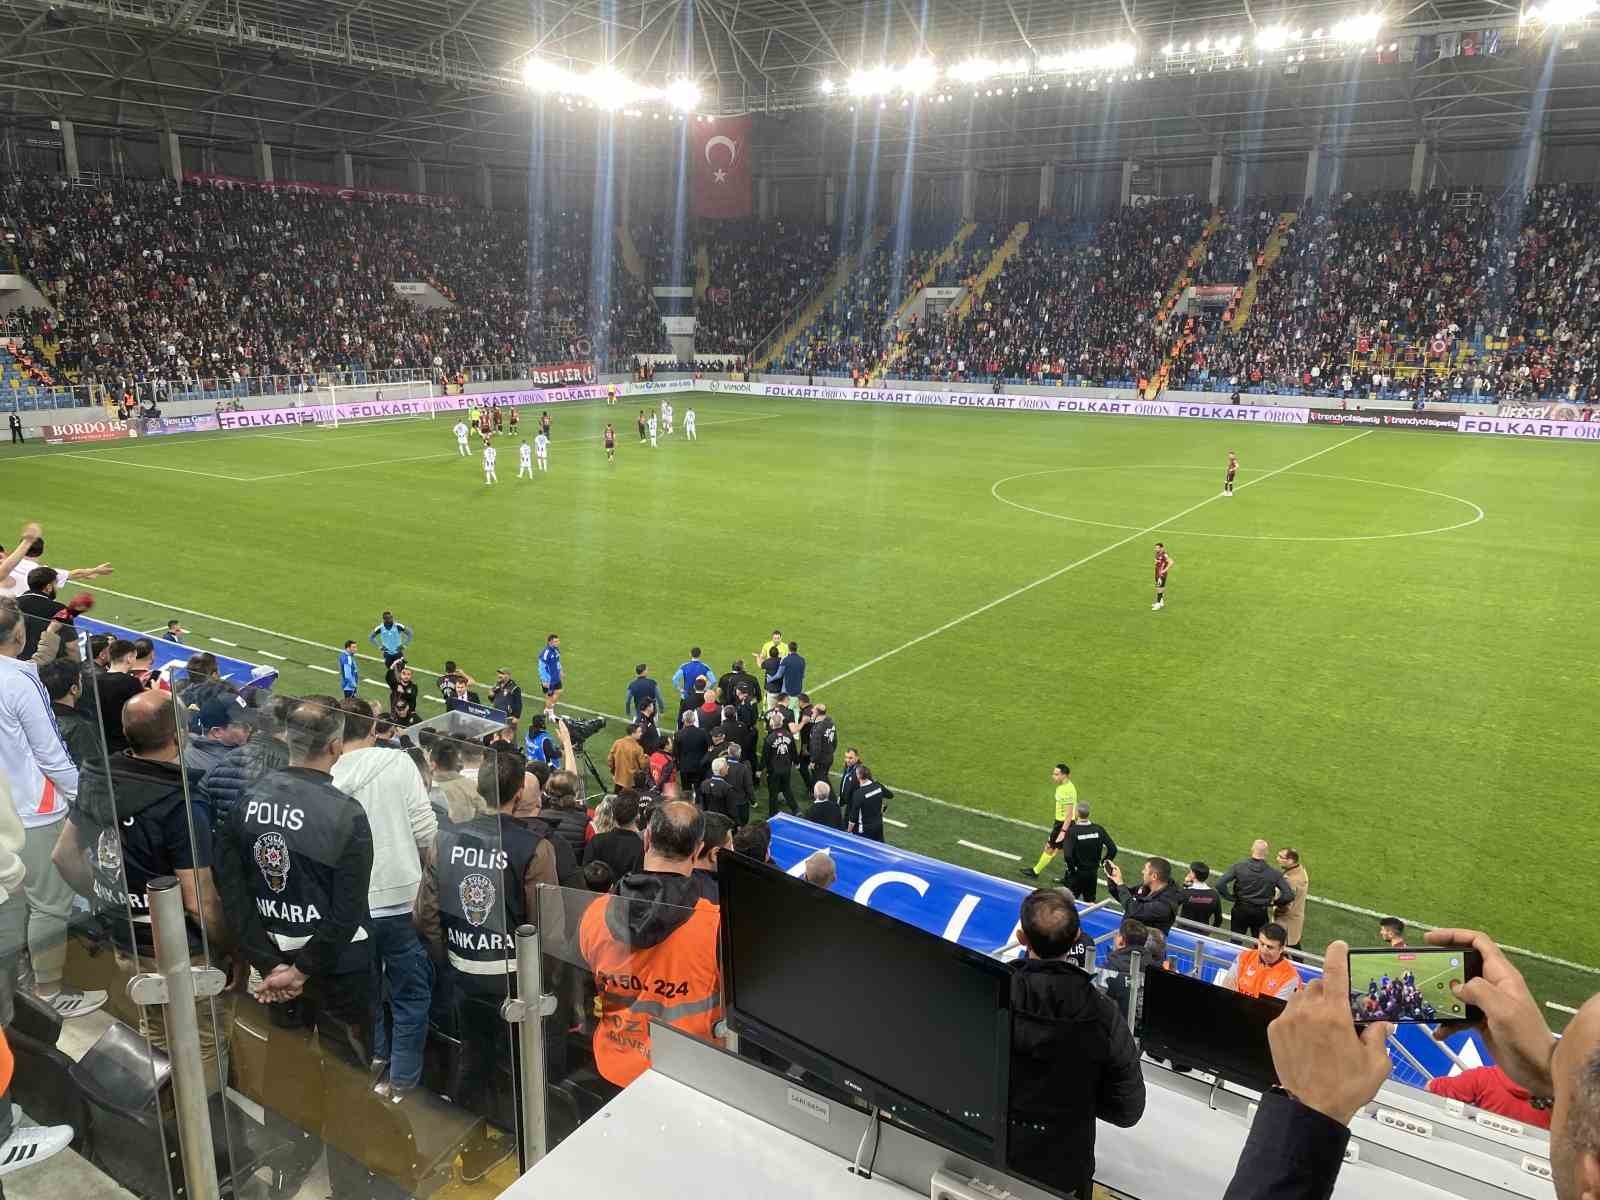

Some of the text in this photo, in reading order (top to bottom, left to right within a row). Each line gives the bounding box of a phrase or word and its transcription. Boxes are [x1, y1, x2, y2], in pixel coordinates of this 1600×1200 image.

[352, 402, 419, 417] FOLKART
[548, 390, 597, 402] FOLKART
[765, 386, 818, 397] FOLKART
[853, 391, 912, 402] FOLKART
[950, 395, 1016, 407] FOLKART
[1057, 401, 1131, 413] FOLKART
[1178, 406, 1261, 420] FOLKART
[53, 420, 128, 436] BORDO 145
[1464, 421, 1568, 437] FOLKART
[447, 927, 515, 950] ANKARA
[654, 979, 689, 998] 224
